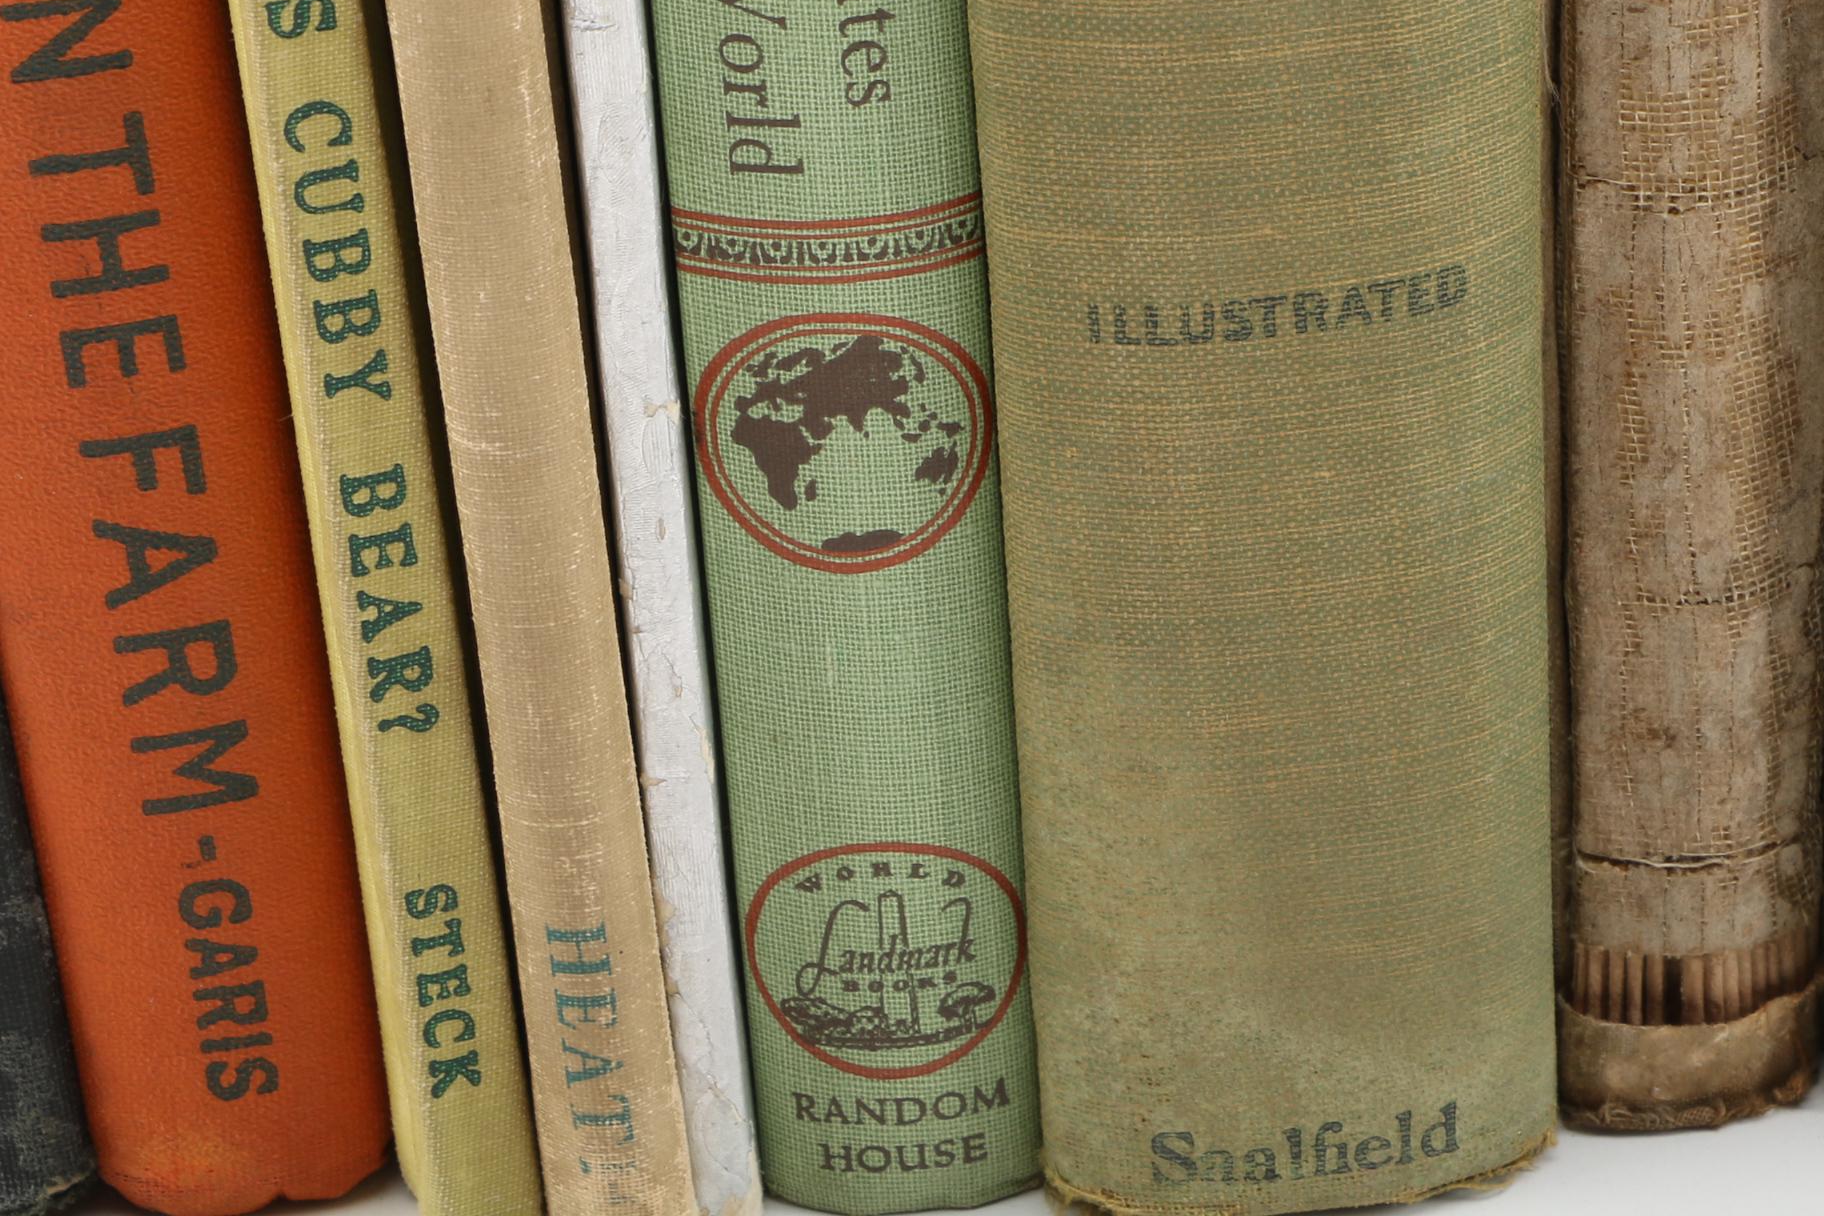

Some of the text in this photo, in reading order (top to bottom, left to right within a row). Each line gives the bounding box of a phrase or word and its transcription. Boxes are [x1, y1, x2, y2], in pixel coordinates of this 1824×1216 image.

[28, 111, 186, 388] THE
[1087, 264, 1470, 346] ILLUSTRATED
[283, 99, 392, 401] CUBBY
[340, 462, 439, 734] BEAR?
[79, 424, 261, 817] FARM
[795, 862, 966, 894] WORLD
[404, 882, 484, 1100] STECK
[796, 898, 976, 997] Landmark
[792, 1078, 1010, 1126] RANDOM
[1151, 1101, 1460, 1184] Saalfield
[820, 1133, 988, 1173] HOUSE
